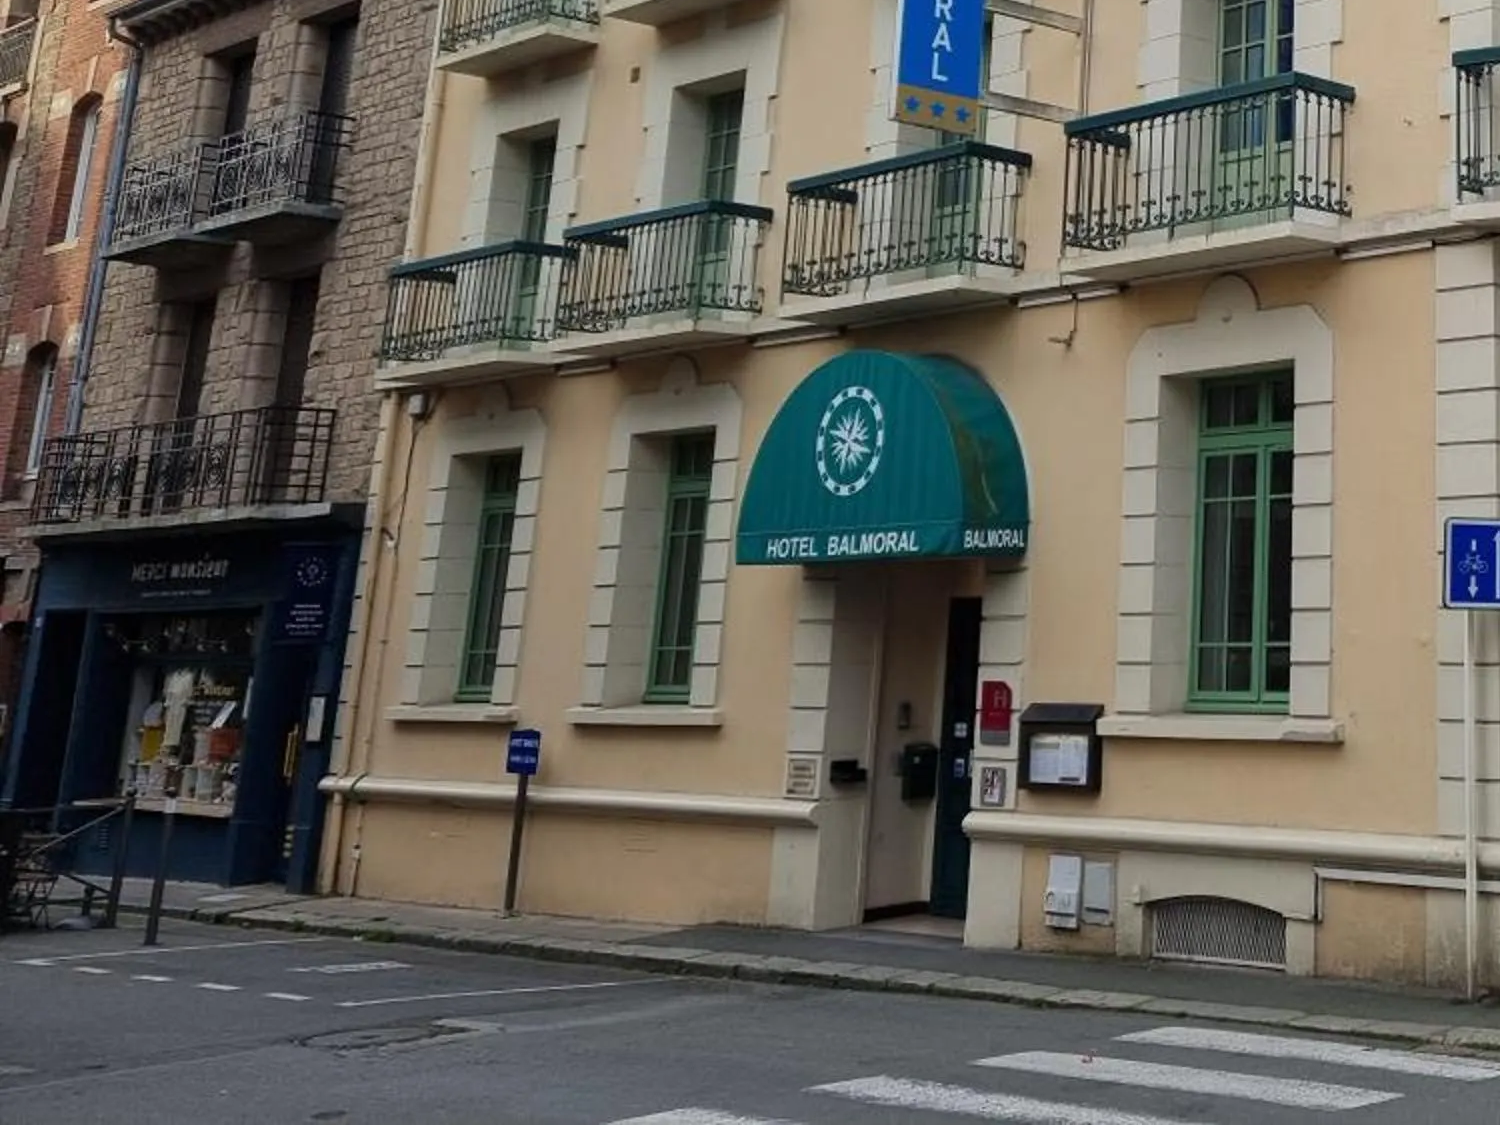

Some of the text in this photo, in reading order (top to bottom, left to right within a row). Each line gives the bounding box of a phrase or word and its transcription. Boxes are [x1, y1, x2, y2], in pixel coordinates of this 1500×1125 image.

[767, 530, 920, 559] HOTEL BALMORAL
[963, 528, 1025, 549] BALMORAL
